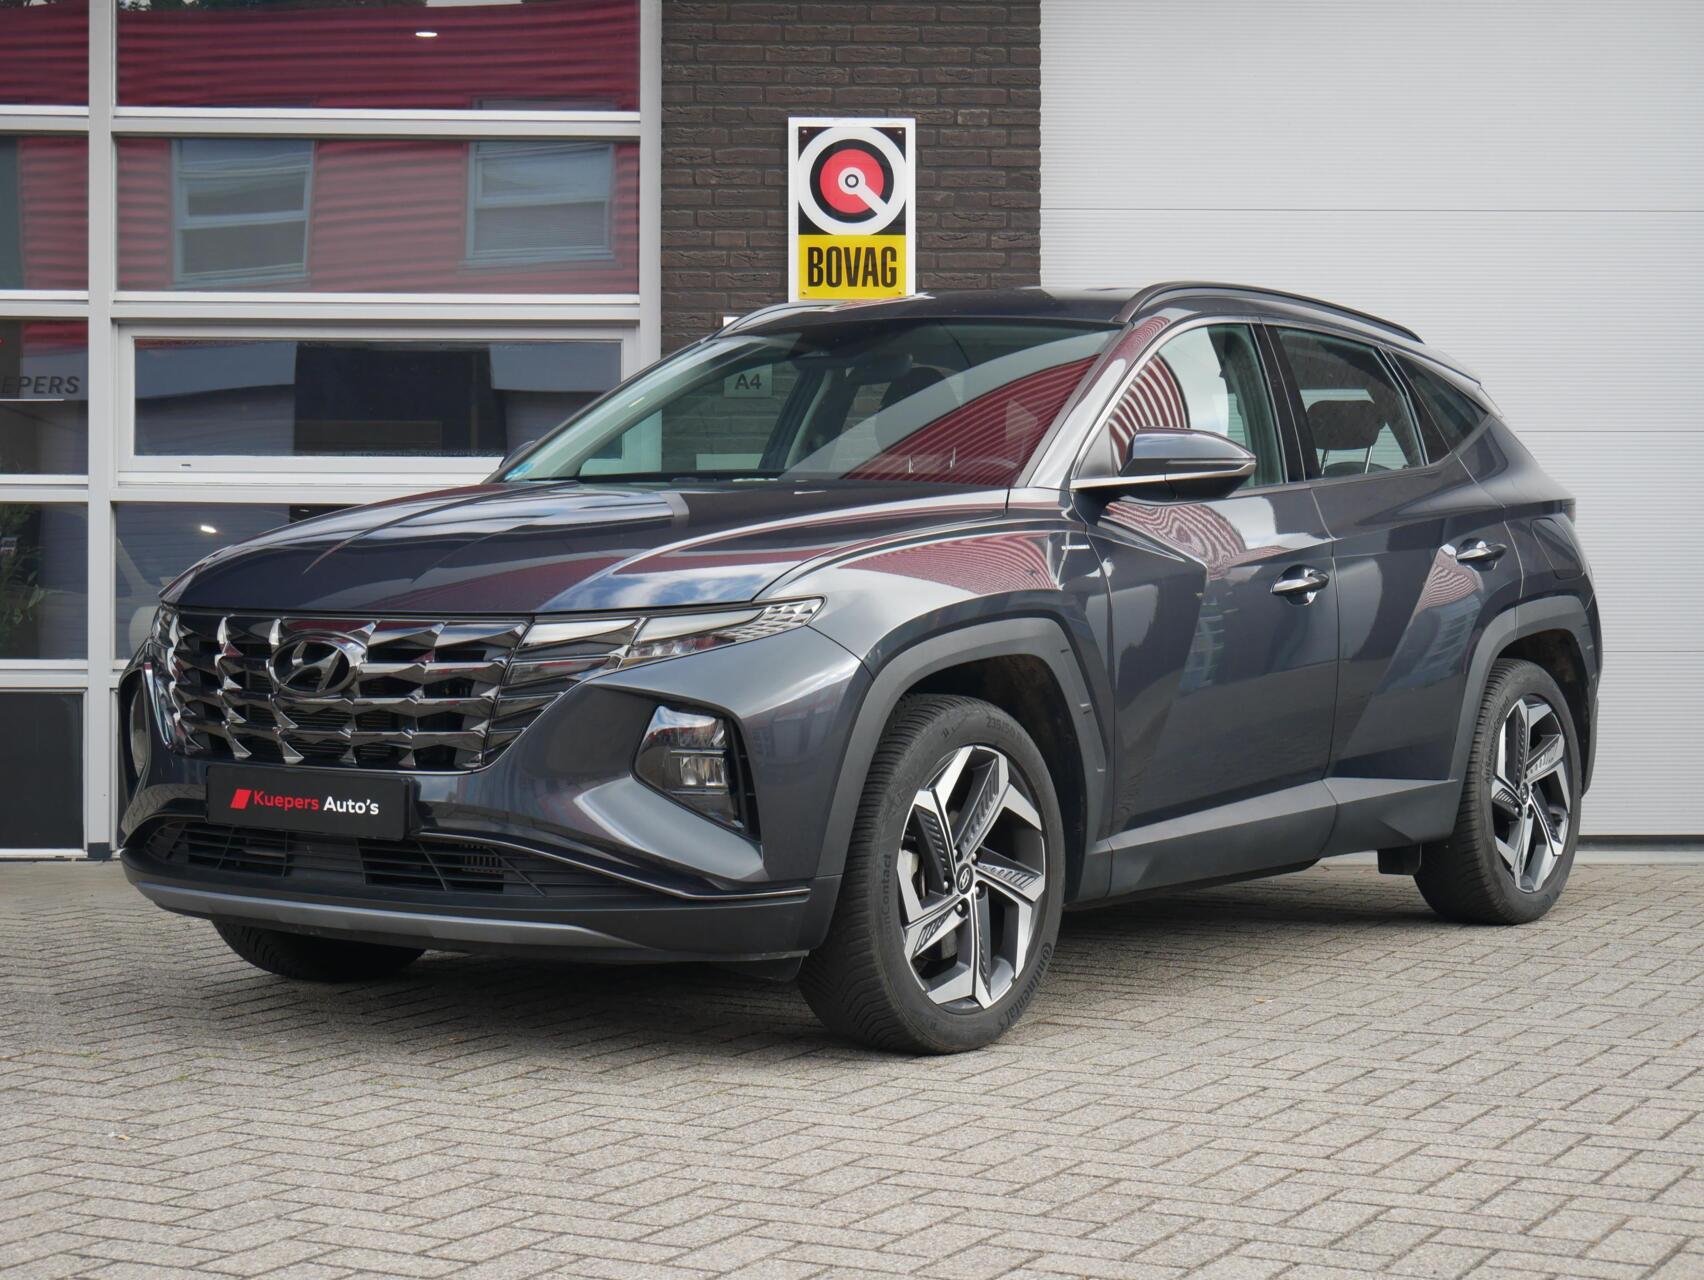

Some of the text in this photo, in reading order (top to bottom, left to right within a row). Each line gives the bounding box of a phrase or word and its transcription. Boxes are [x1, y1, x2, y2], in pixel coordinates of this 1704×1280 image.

[807, 246, 897, 287] BOVAG
[734, 373, 762, 390] A4
[253, 790, 380, 815] Kuepers Auto’s
